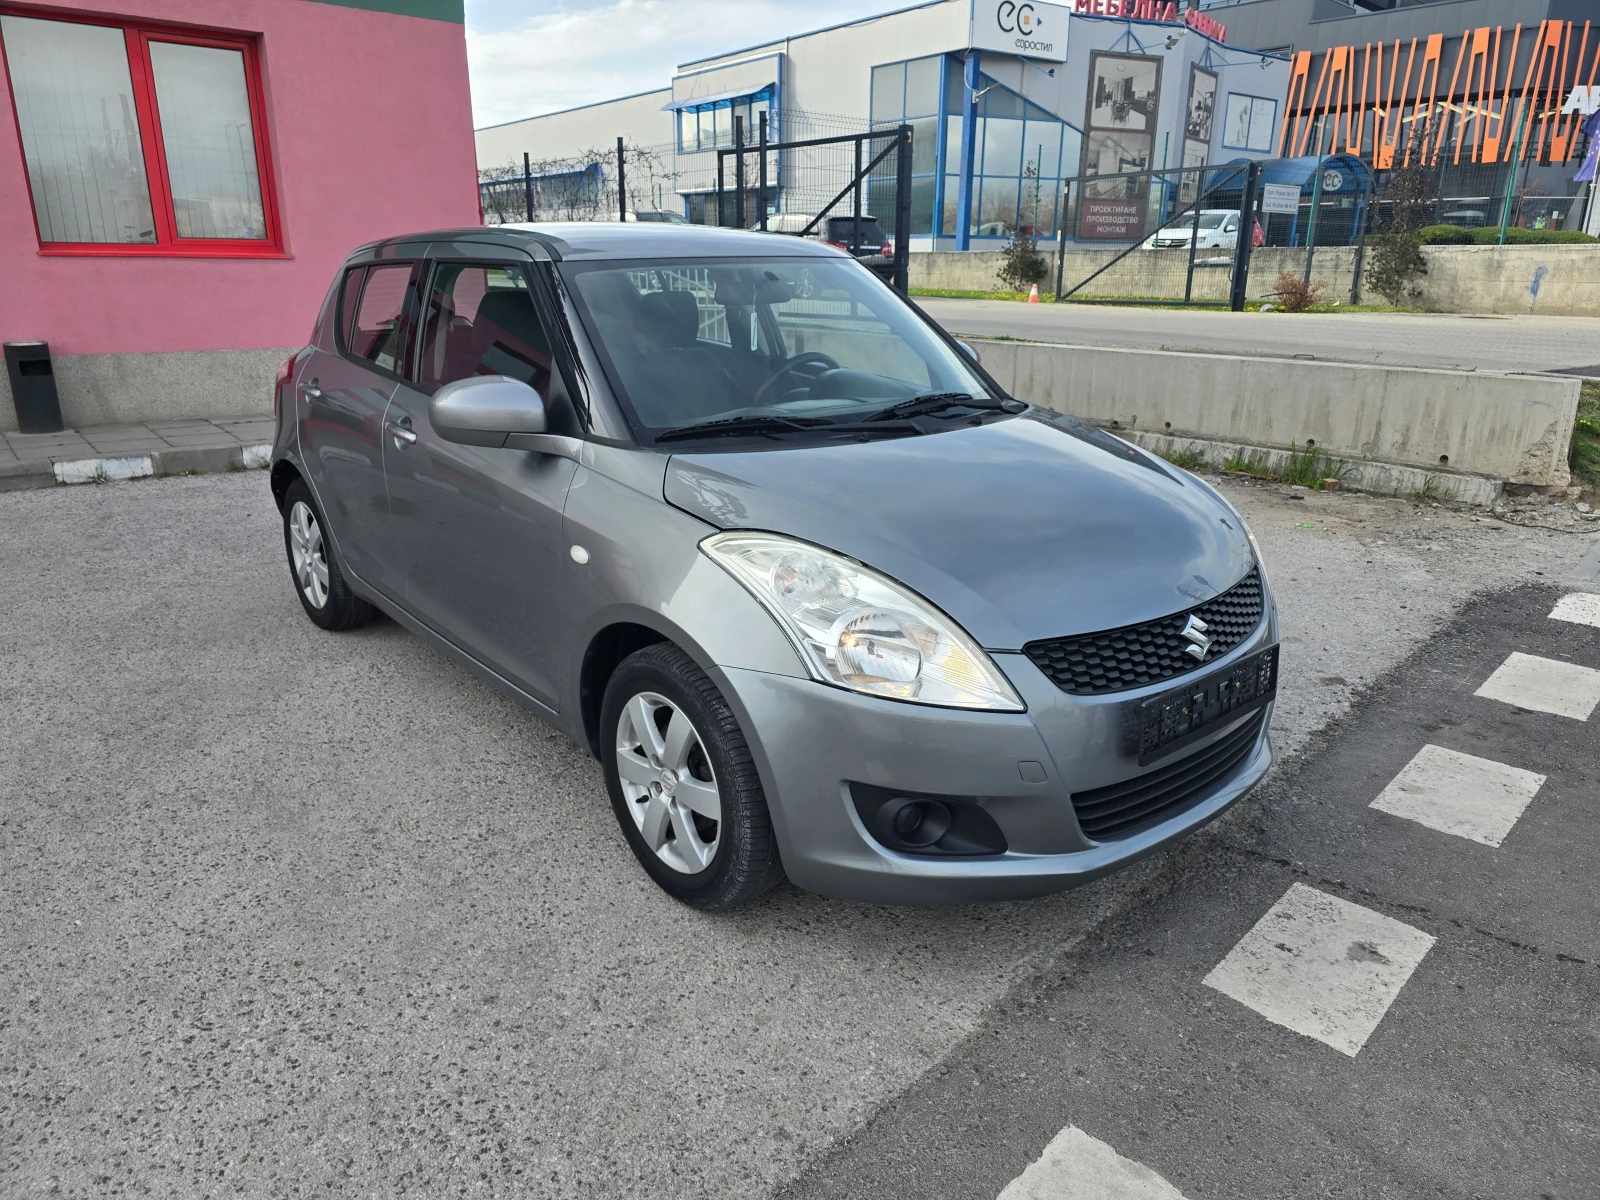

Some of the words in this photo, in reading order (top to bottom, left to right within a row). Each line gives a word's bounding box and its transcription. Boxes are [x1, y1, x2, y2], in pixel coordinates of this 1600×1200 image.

[1074, 0, 1178, 23] МЕБЕЛНА
[1015, 38, 1053, 53] евростил
[1090, 205, 1137, 214] ПРОЕКТИРАНЕ
[1086, 215, 1139, 224] ПРОИЗВОДСТВО
[1096, 225, 1127, 233] МОНТАЖ
